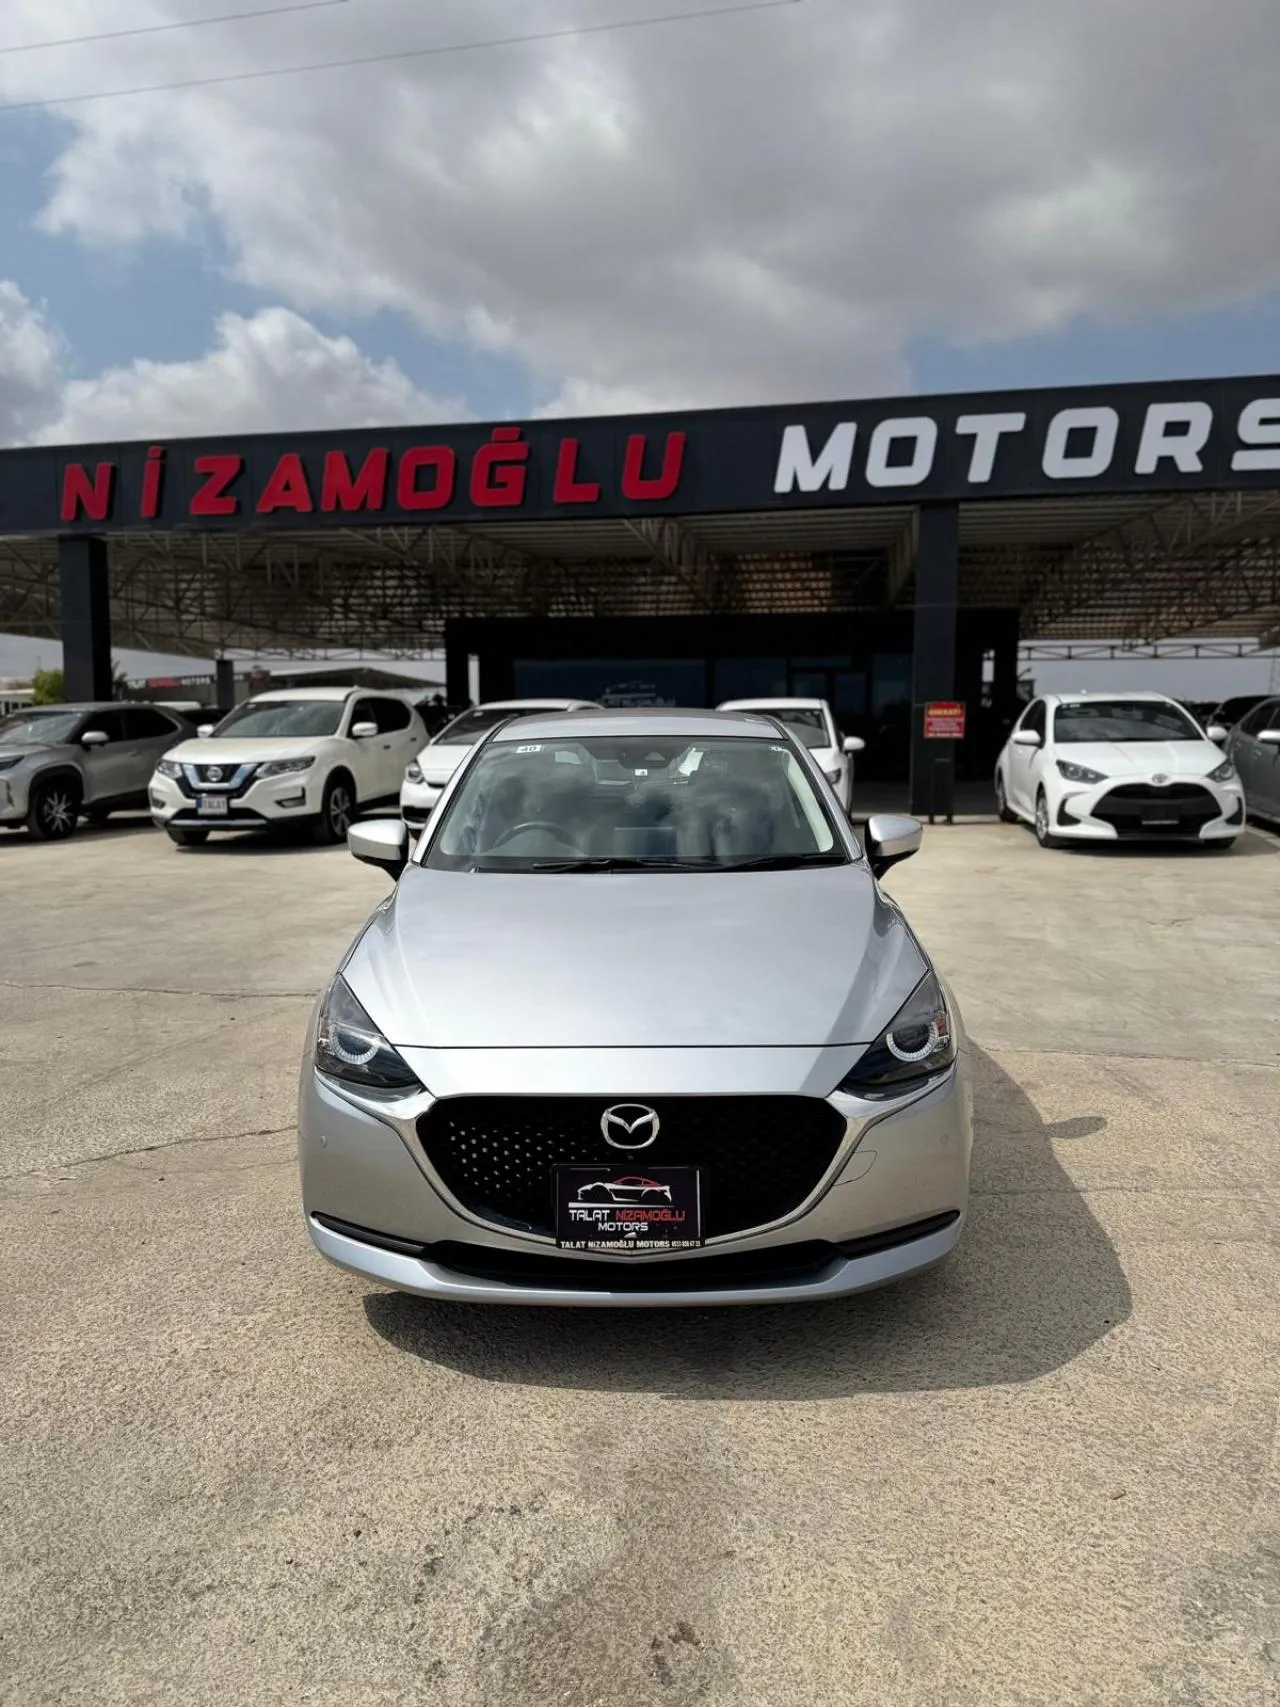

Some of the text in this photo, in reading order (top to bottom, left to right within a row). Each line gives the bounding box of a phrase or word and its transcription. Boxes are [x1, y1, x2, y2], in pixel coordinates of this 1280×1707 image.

[60, 398, 1280, 521] NİZAMOĞLU MOTORS
[569, 1208, 685, 1222] TALAT NİZAMOĞLU
[597, 1222, 649, 1232] MOTORS
[560, 1241, 586, 1249] TALAT
[636, 1240, 671, 1248] MOTORS
